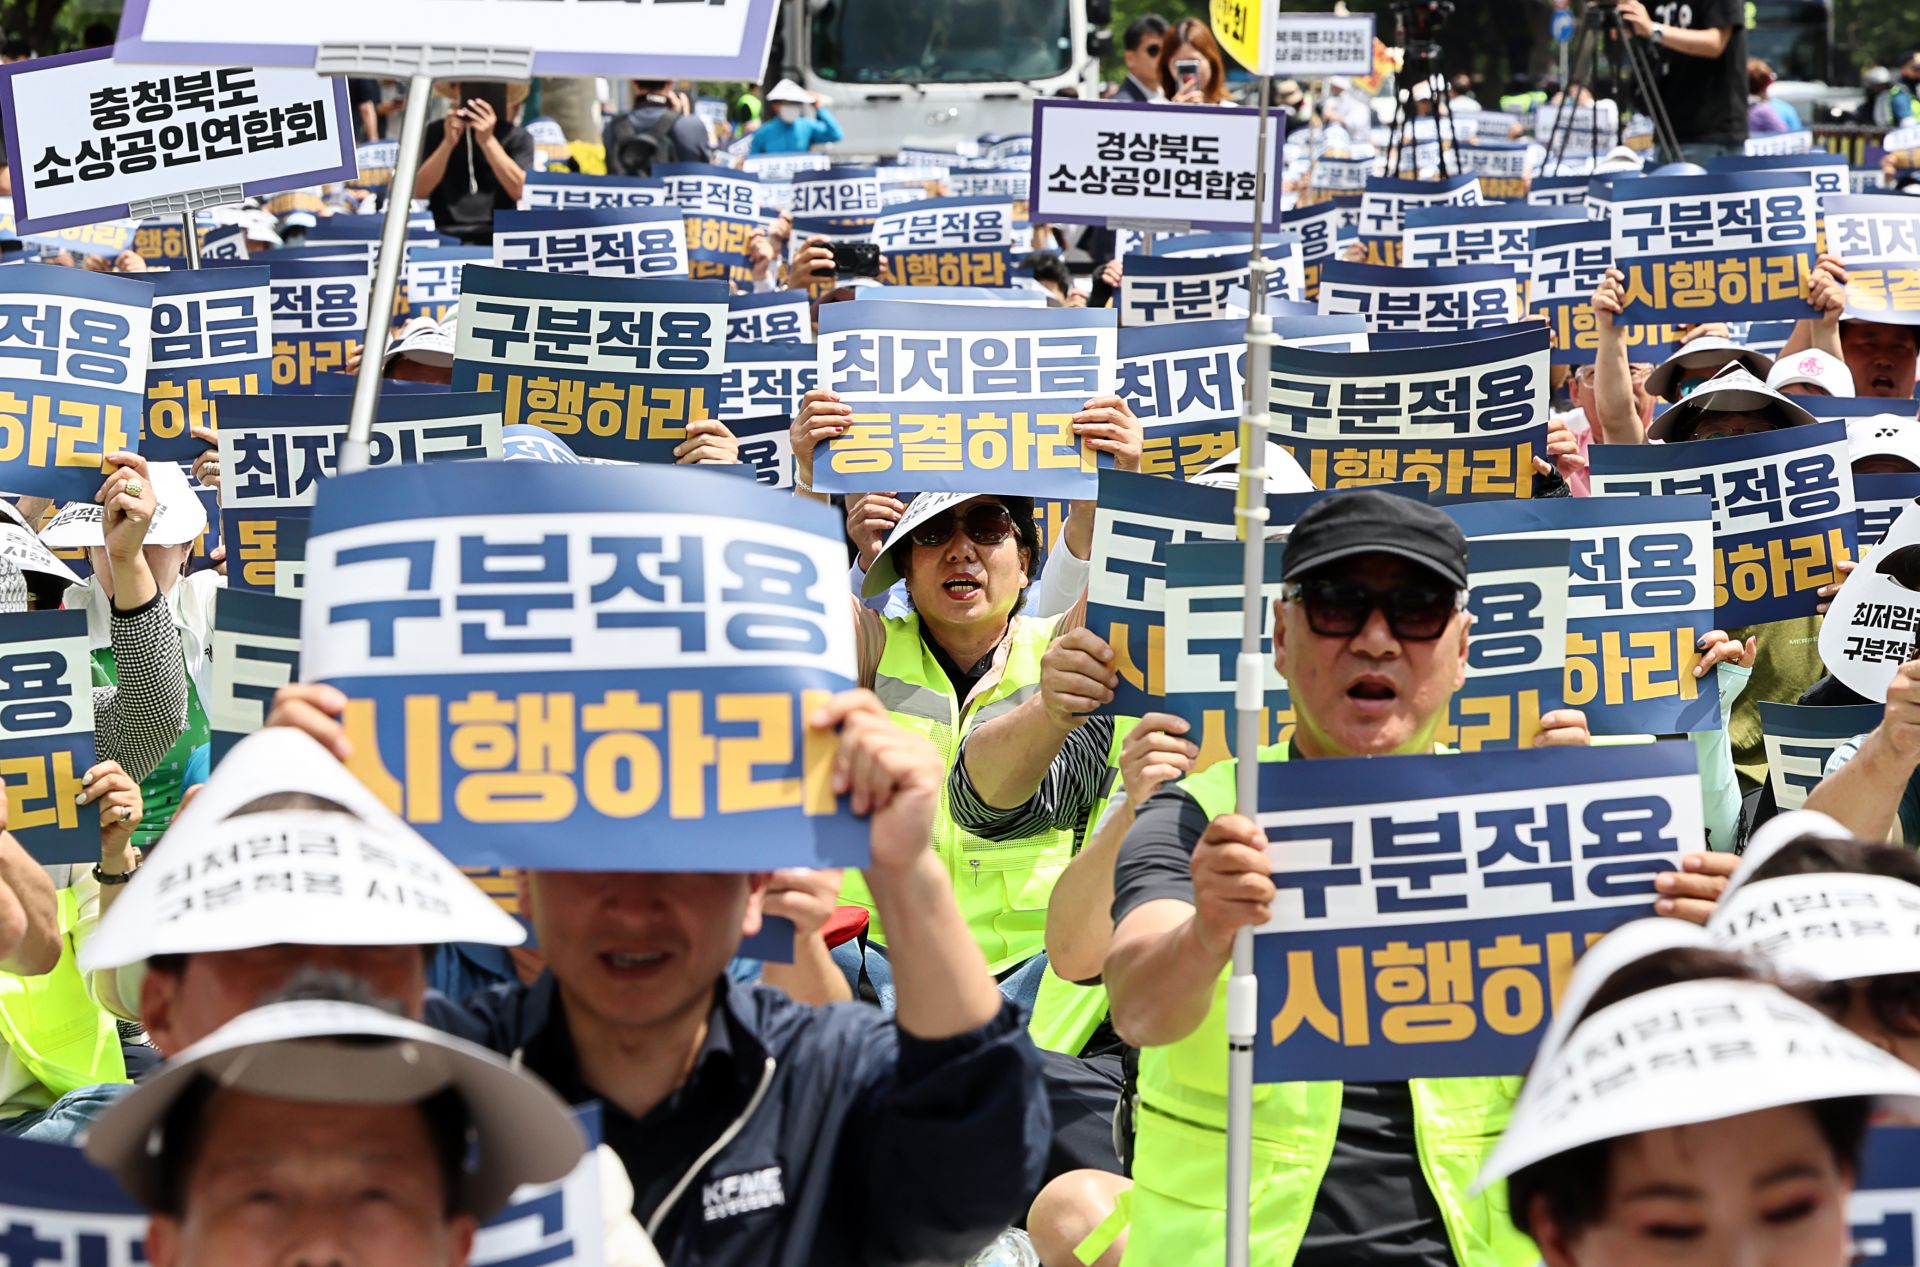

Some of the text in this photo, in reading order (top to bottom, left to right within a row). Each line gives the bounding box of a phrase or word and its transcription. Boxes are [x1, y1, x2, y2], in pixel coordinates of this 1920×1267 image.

[90, 67, 258, 131] 충청북도
[34, 100, 327, 189] 소상공인연합회
[1097, 131, 1219, 165] 경상북도
[792, 184, 878, 212] 최저임금
[1049, 164, 1266, 202] 소상공인연합회
[502, 228, 677, 274] 구분적용
[879, 211, 1002, 245] 구분적용
[1622, 195, 1806, 251] 구분적용
[884, 252, 1006, 287] 시행하라
[1622, 254, 1811, 309] 시행하라
[0, 304, 131, 384] 적용
[151, 295, 259, 362] 임금
[472, 301, 712, 369] 구분적용
[833, 335, 1100, 394] 최저임금
[1116, 351, 1247, 418] 최저
[0, 391, 127, 474] 하라
[1271, 364, 1536, 435] 구분적용
[829, 412, 1098, 474] 동결하라
[330, 534, 829, 658] 구분적용
[0, 651, 72, 732] 용
[343, 690, 839, 824] 시행하라
[1265, 796, 1680, 918] 구분적용
[1271, 931, 1603, 1047] 시행하
